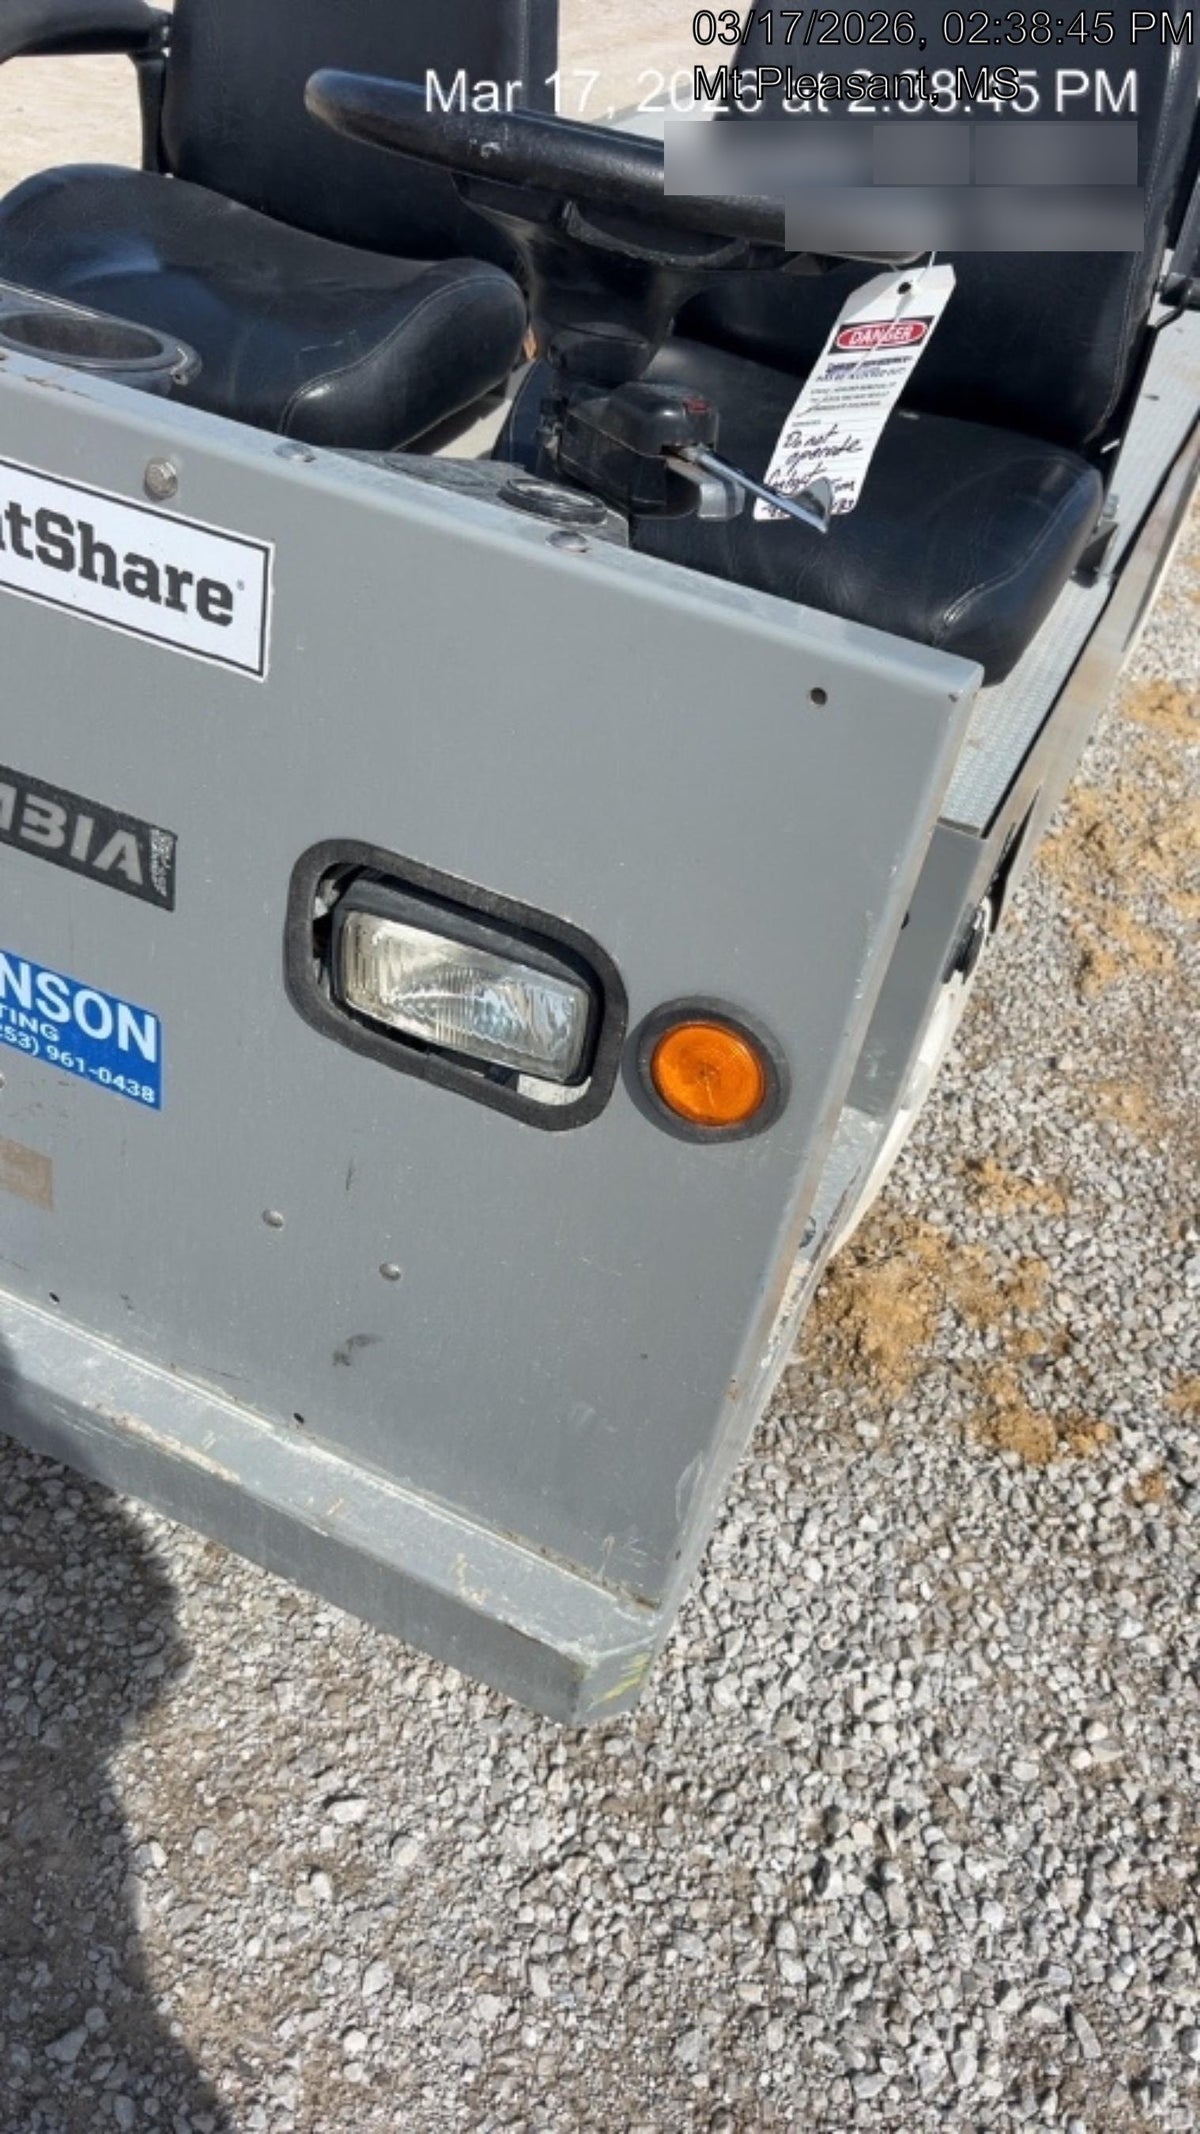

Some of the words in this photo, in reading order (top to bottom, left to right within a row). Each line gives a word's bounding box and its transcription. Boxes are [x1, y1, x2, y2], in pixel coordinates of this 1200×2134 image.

[849, 323, 914, 346] DANGER
[0, 501, 233, 627] tShare
[46, 1045, 155, 1104] 961-0438
